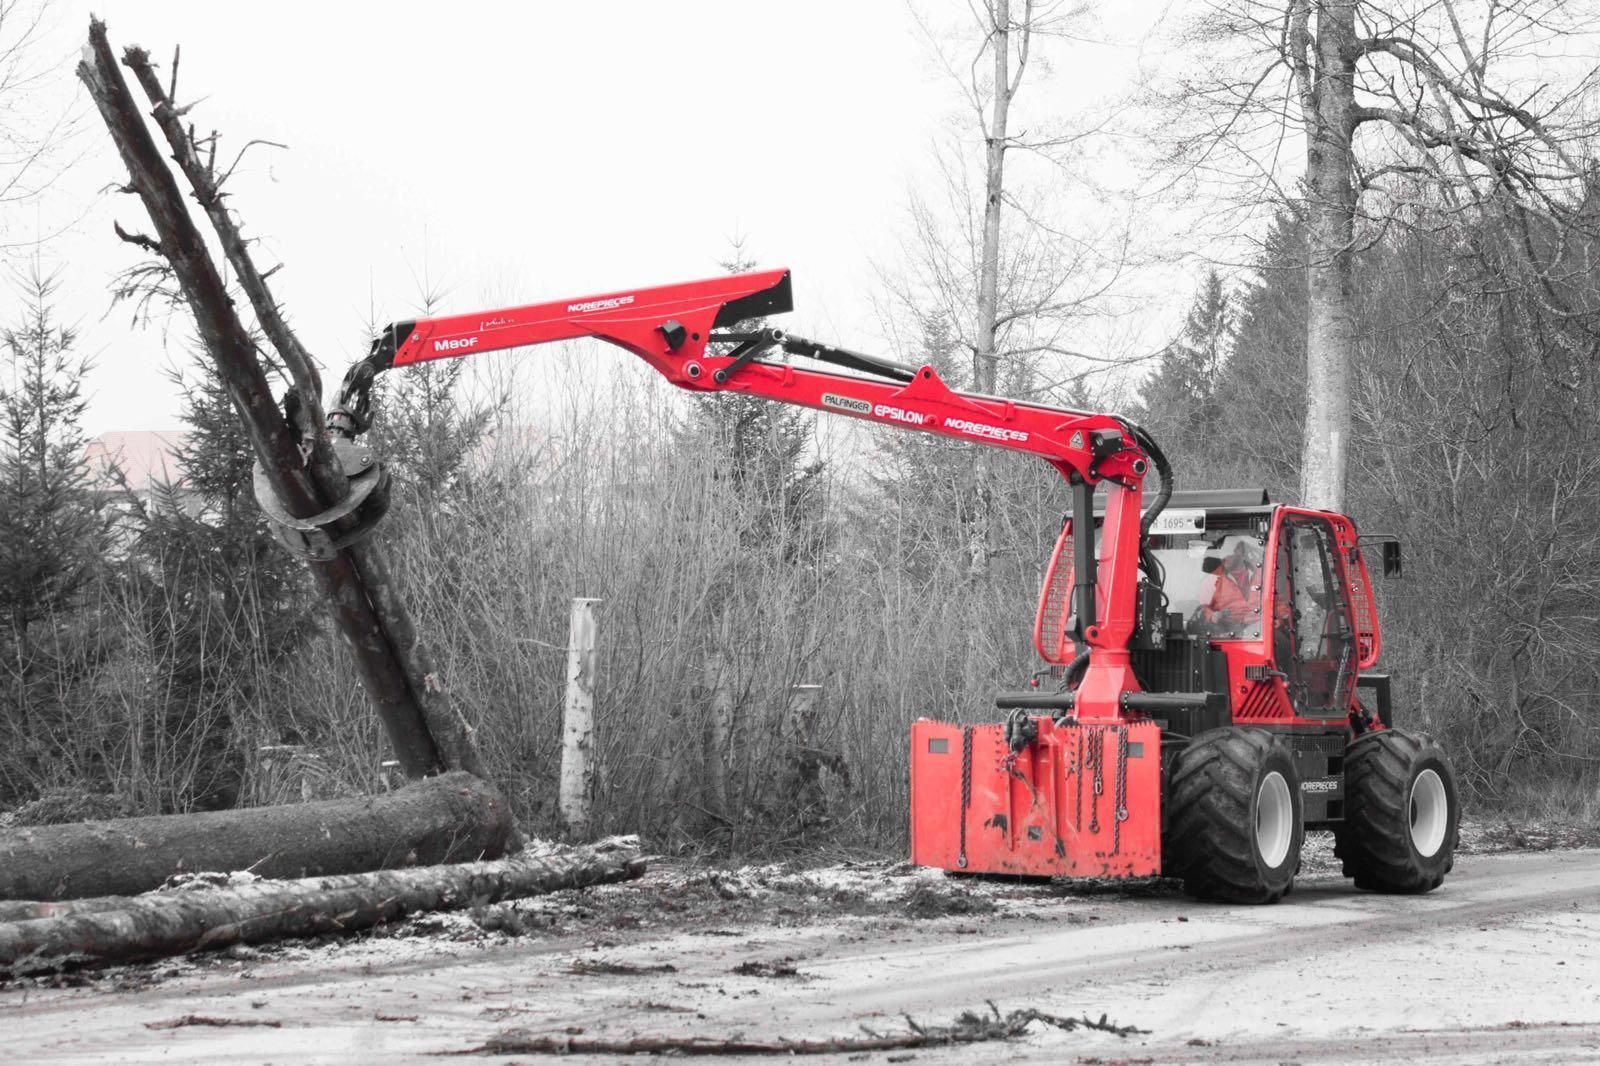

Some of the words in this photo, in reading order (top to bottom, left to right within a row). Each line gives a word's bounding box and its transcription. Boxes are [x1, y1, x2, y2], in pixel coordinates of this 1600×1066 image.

[567, 295, 635, 313] NOREPIECES
[434, 336, 479, 352] M80F
[874, 404, 924, 425] EPSILON
[943, 417, 1029, 442] NOREPIECES
[1163, 517, 1184, 529] 1695
